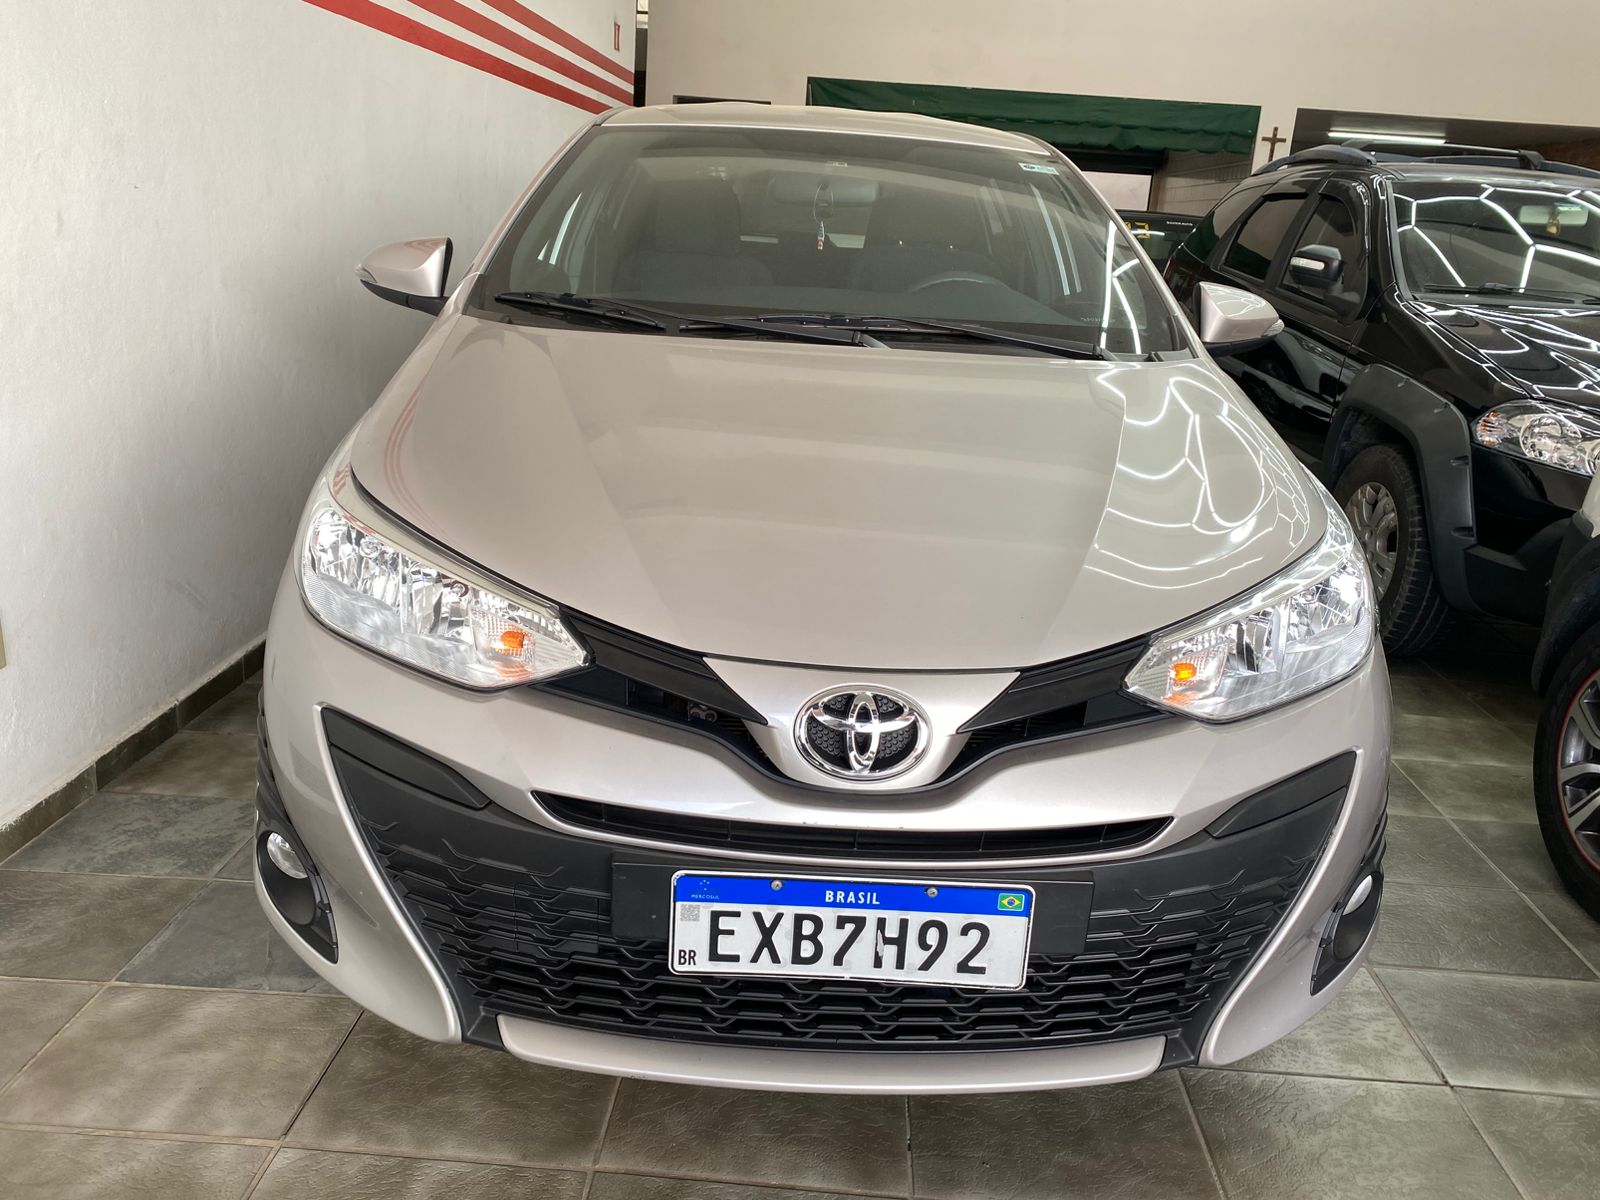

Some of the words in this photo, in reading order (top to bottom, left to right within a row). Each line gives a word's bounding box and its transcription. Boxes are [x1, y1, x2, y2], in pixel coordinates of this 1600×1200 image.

[690, 893, 720, 901] MERCOSUL
[824, 889, 881, 906] BRASIL
[707, 909, 992, 975] EXB7H92
[678, 948, 697, 967] BR
